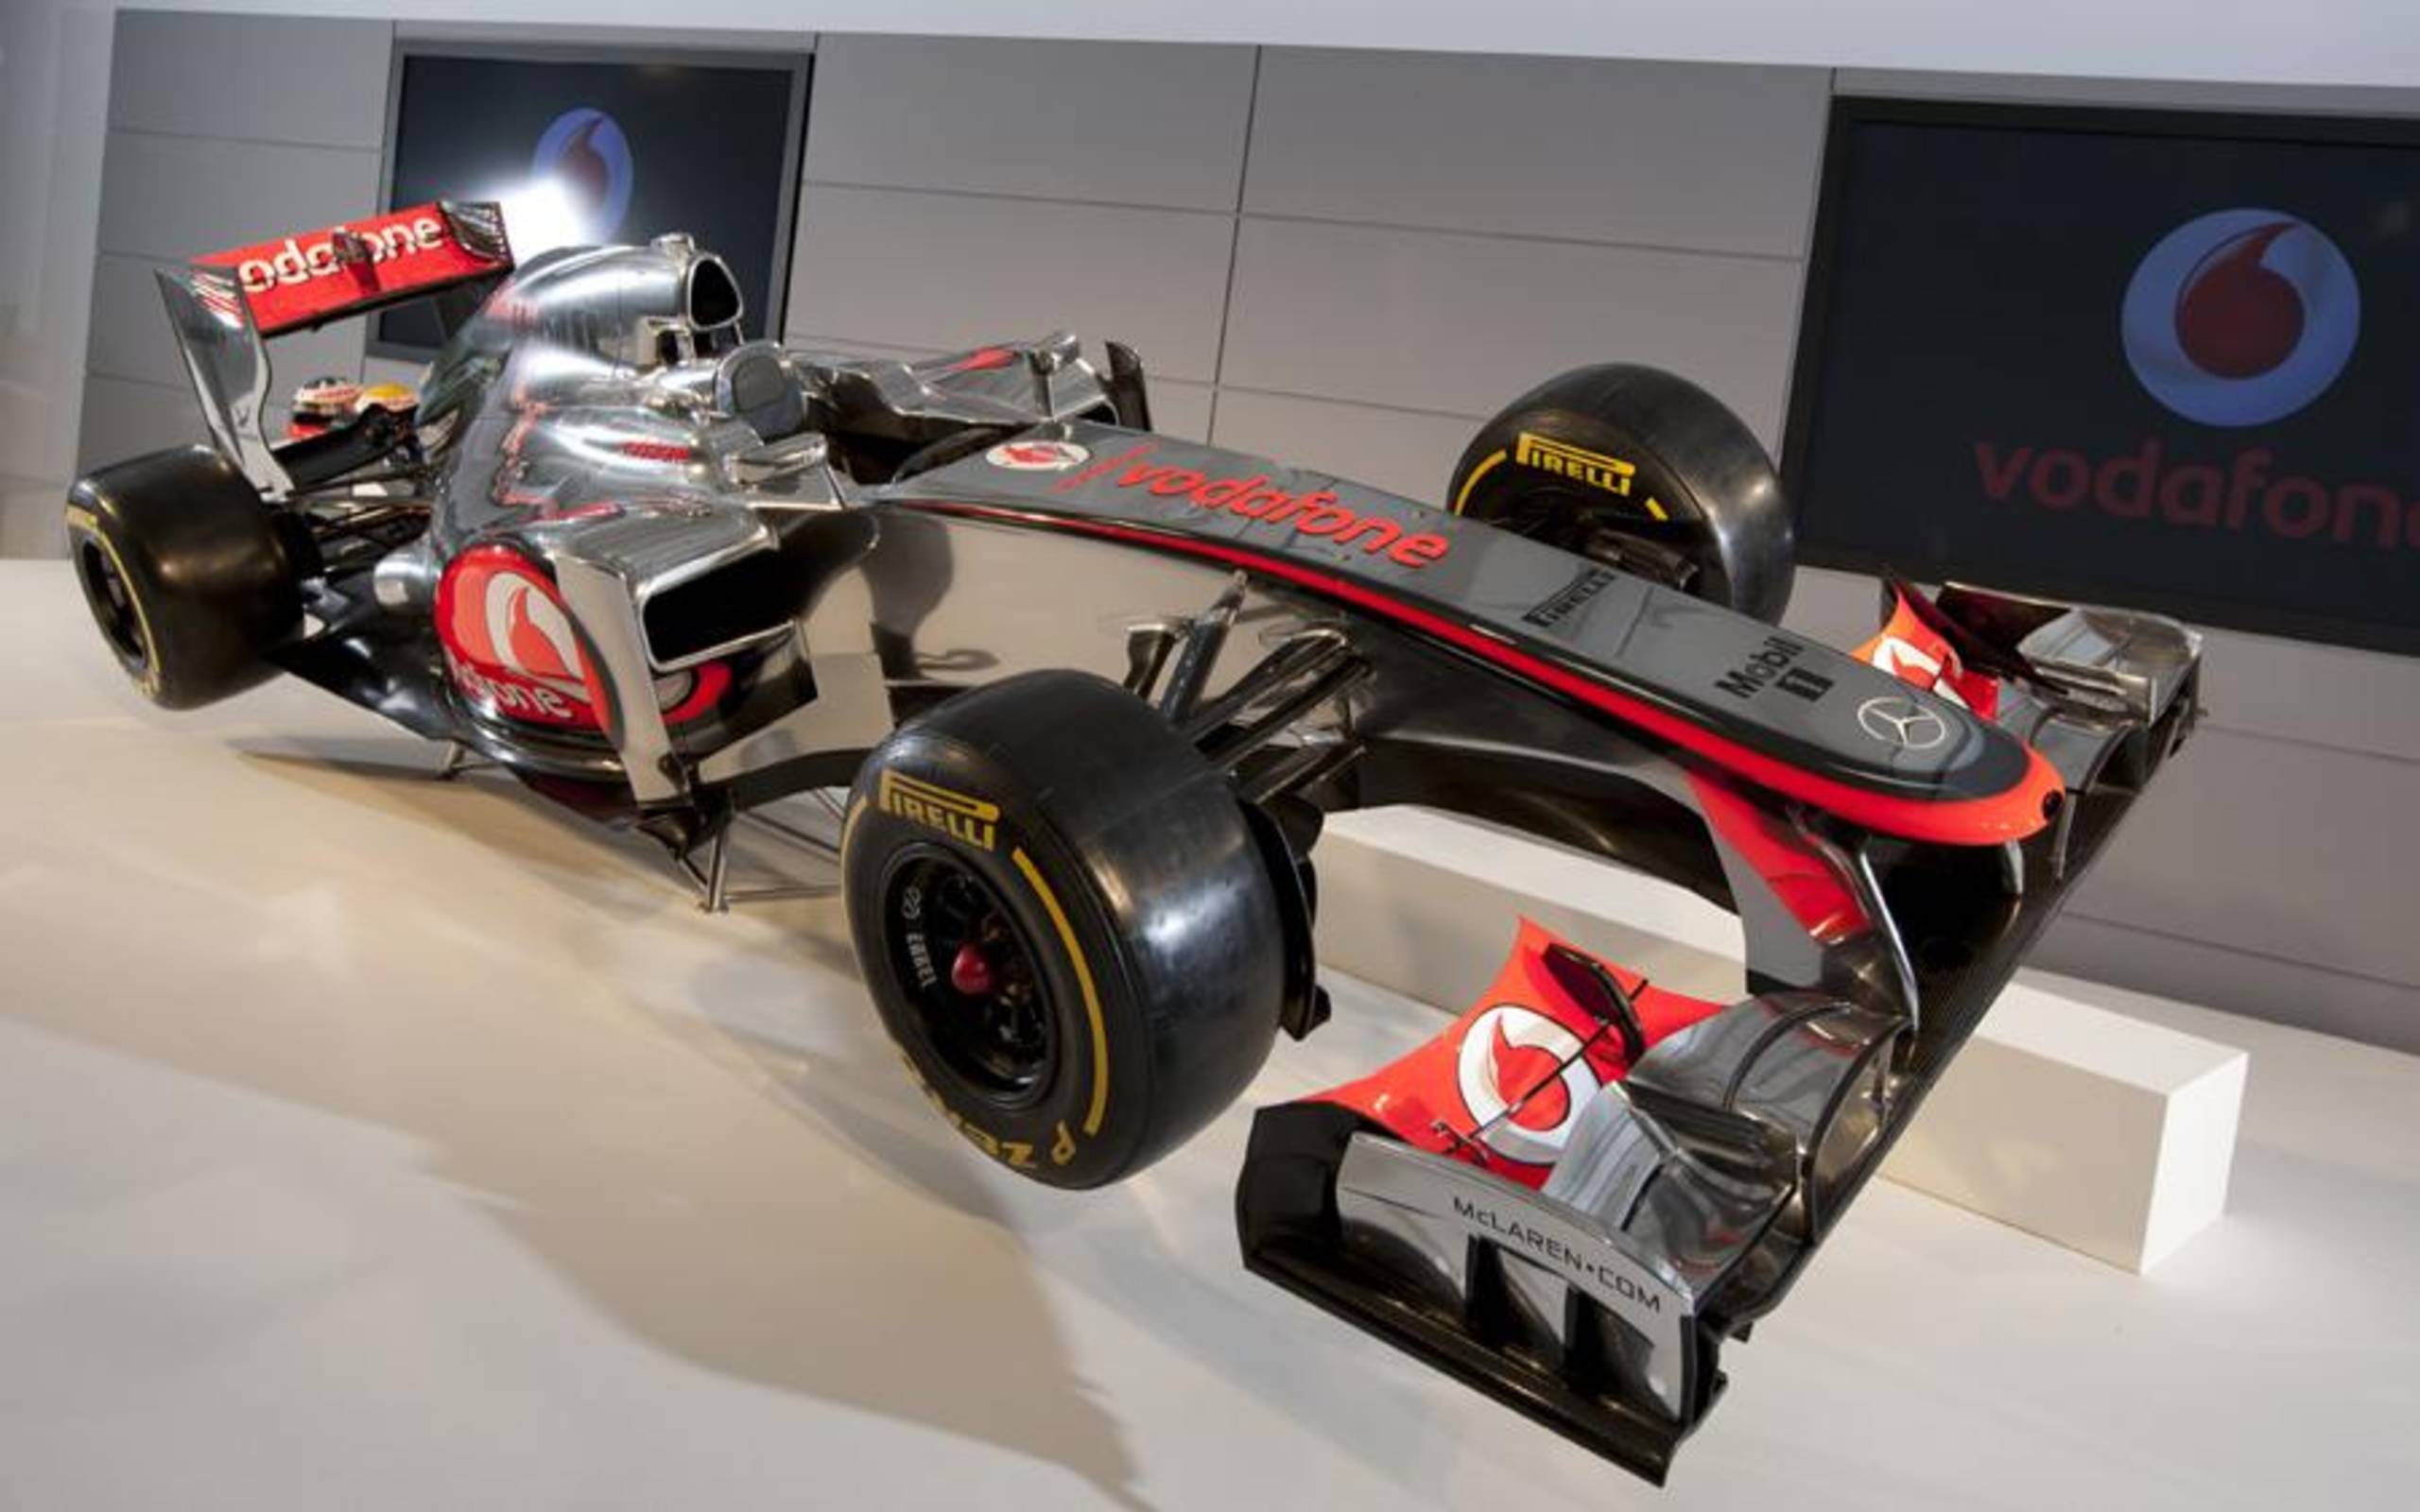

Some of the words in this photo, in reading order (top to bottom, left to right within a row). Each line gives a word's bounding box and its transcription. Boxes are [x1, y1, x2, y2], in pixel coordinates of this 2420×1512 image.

[238, 216, 441, 292] odaone
[1516, 432, 1635, 496] PIRELLI
[1976, 439, 2420, 550] vodafon
[1117, 462, 1451, 568] vodafone
[1521, 567, 1616, 627] PIRELLI
[1715, 636, 1805, 700] Mobil
[880, 769, 1000, 850] PIRELLI
